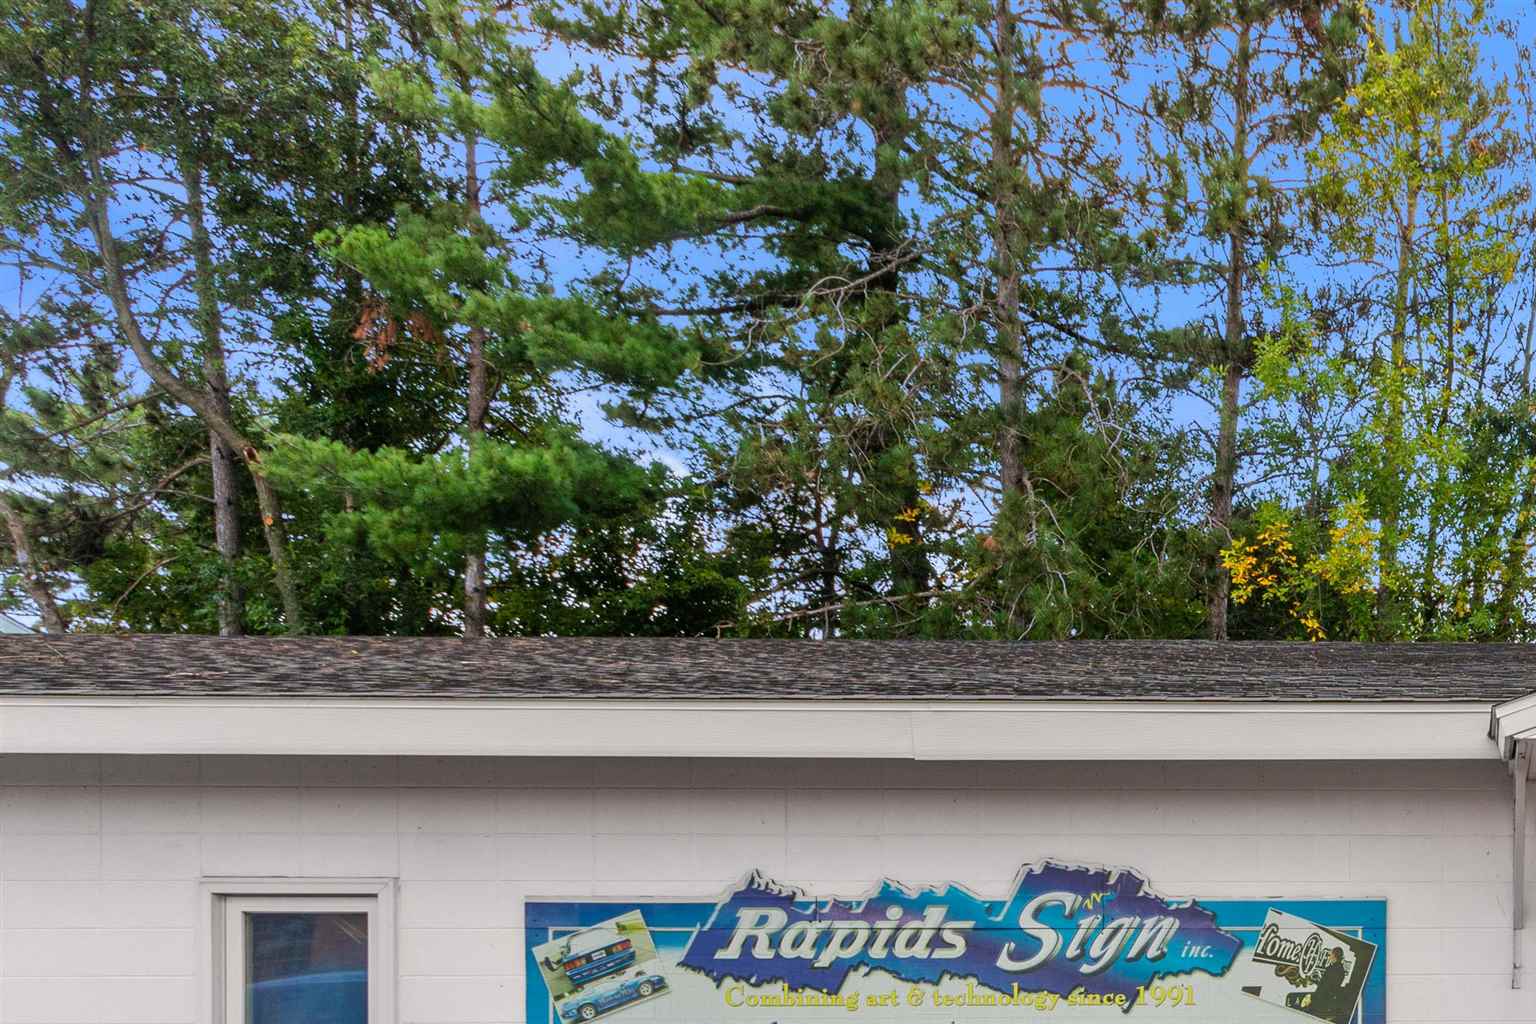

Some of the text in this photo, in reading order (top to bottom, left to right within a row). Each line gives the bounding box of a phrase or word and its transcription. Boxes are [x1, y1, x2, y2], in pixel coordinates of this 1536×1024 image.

[713, 890, 1215, 975] Rapids Sign inc.
[723, 982, 1196, 1012] Combining art & technology since 1991
